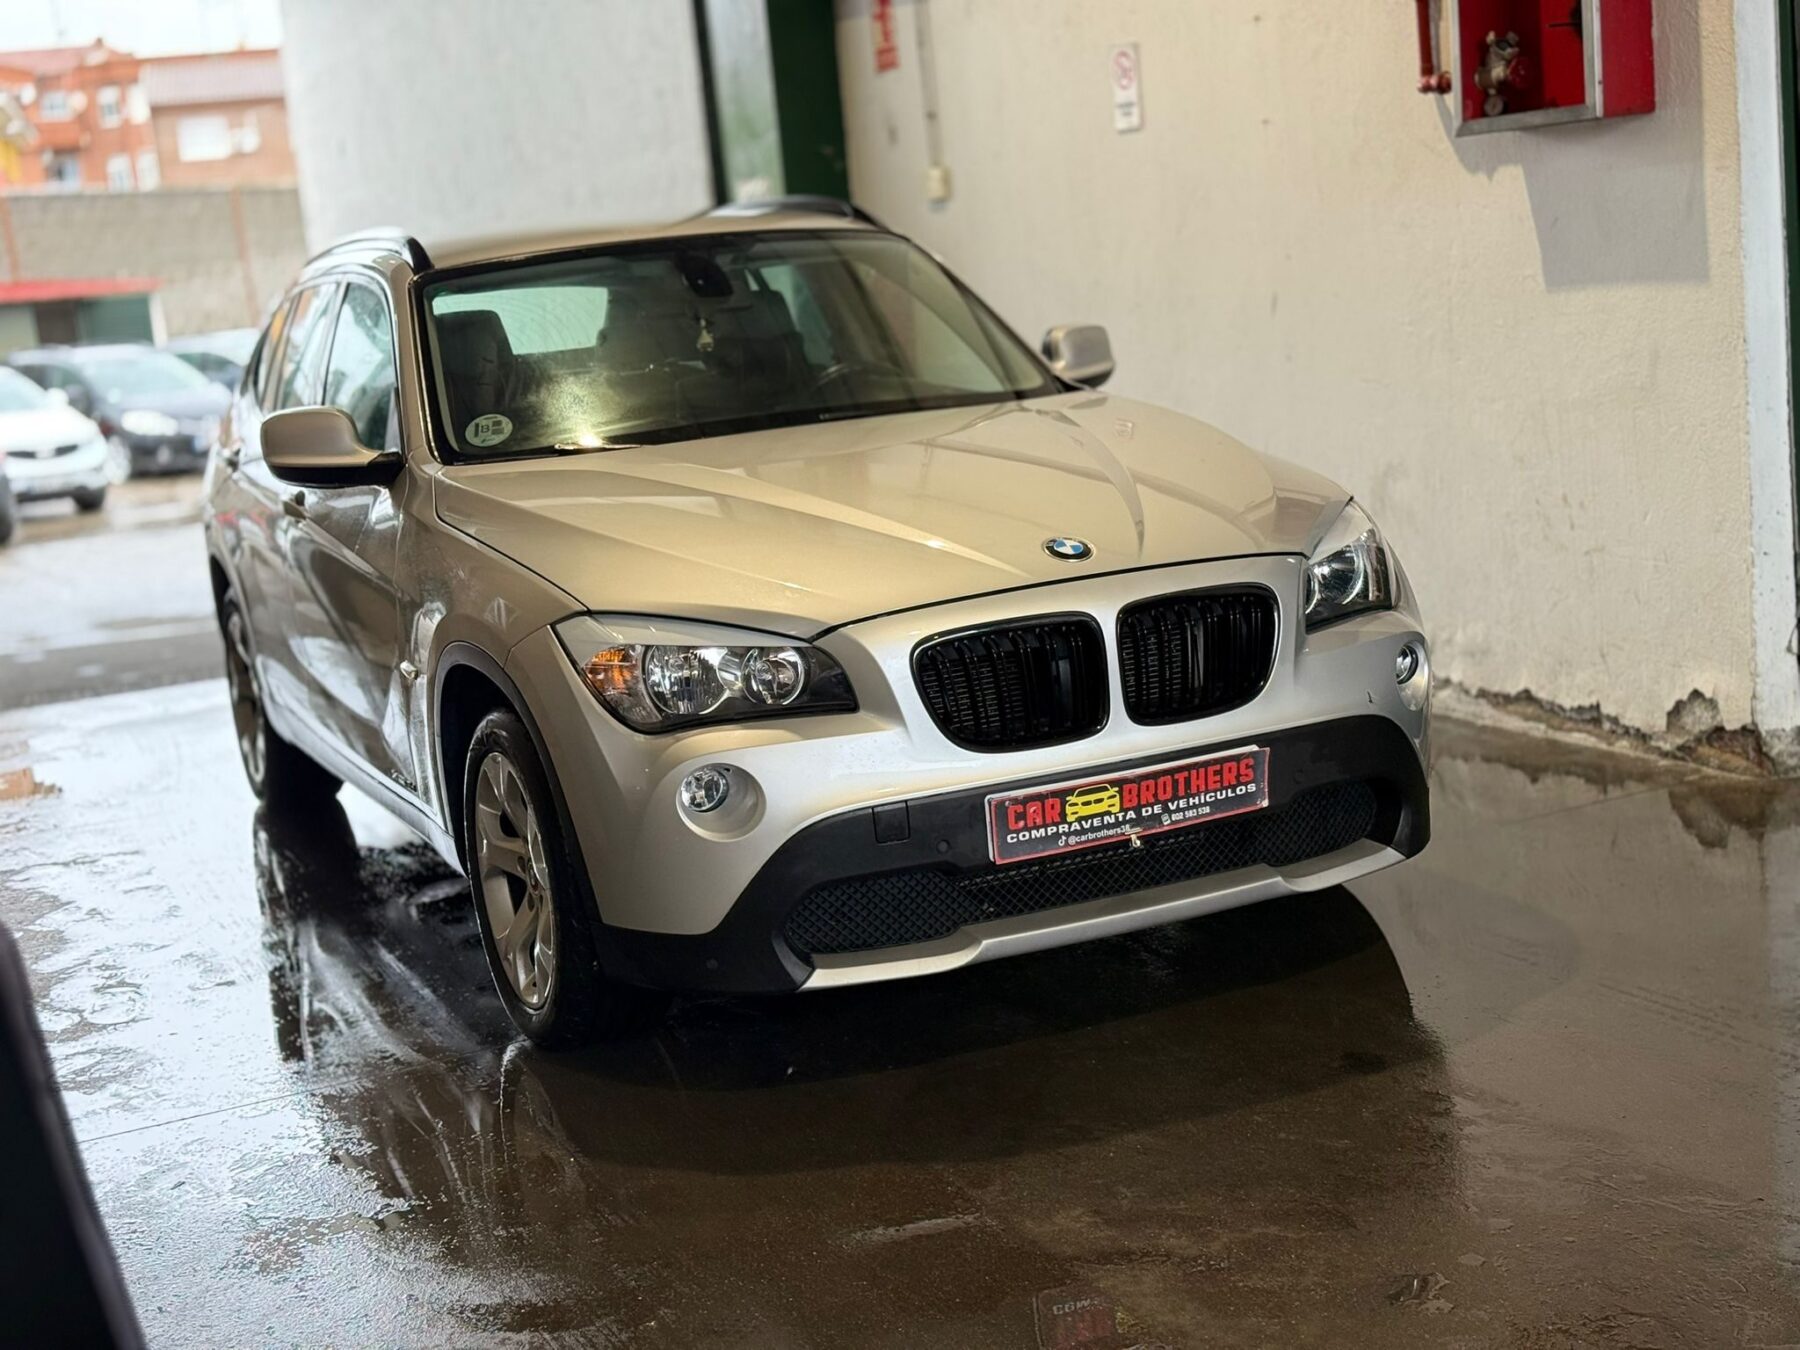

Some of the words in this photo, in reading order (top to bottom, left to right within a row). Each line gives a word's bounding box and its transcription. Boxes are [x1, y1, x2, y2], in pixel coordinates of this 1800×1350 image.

[1006, 810, 1137, 843] COMPRAVENTA
[1141, 804, 1162, 817] DE
[1168, 783, 1257, 810] VEHÍCULOS
[1007, 797, 1061, 830] CAR
[1122, 758, 1254, 808] BROTHERS
